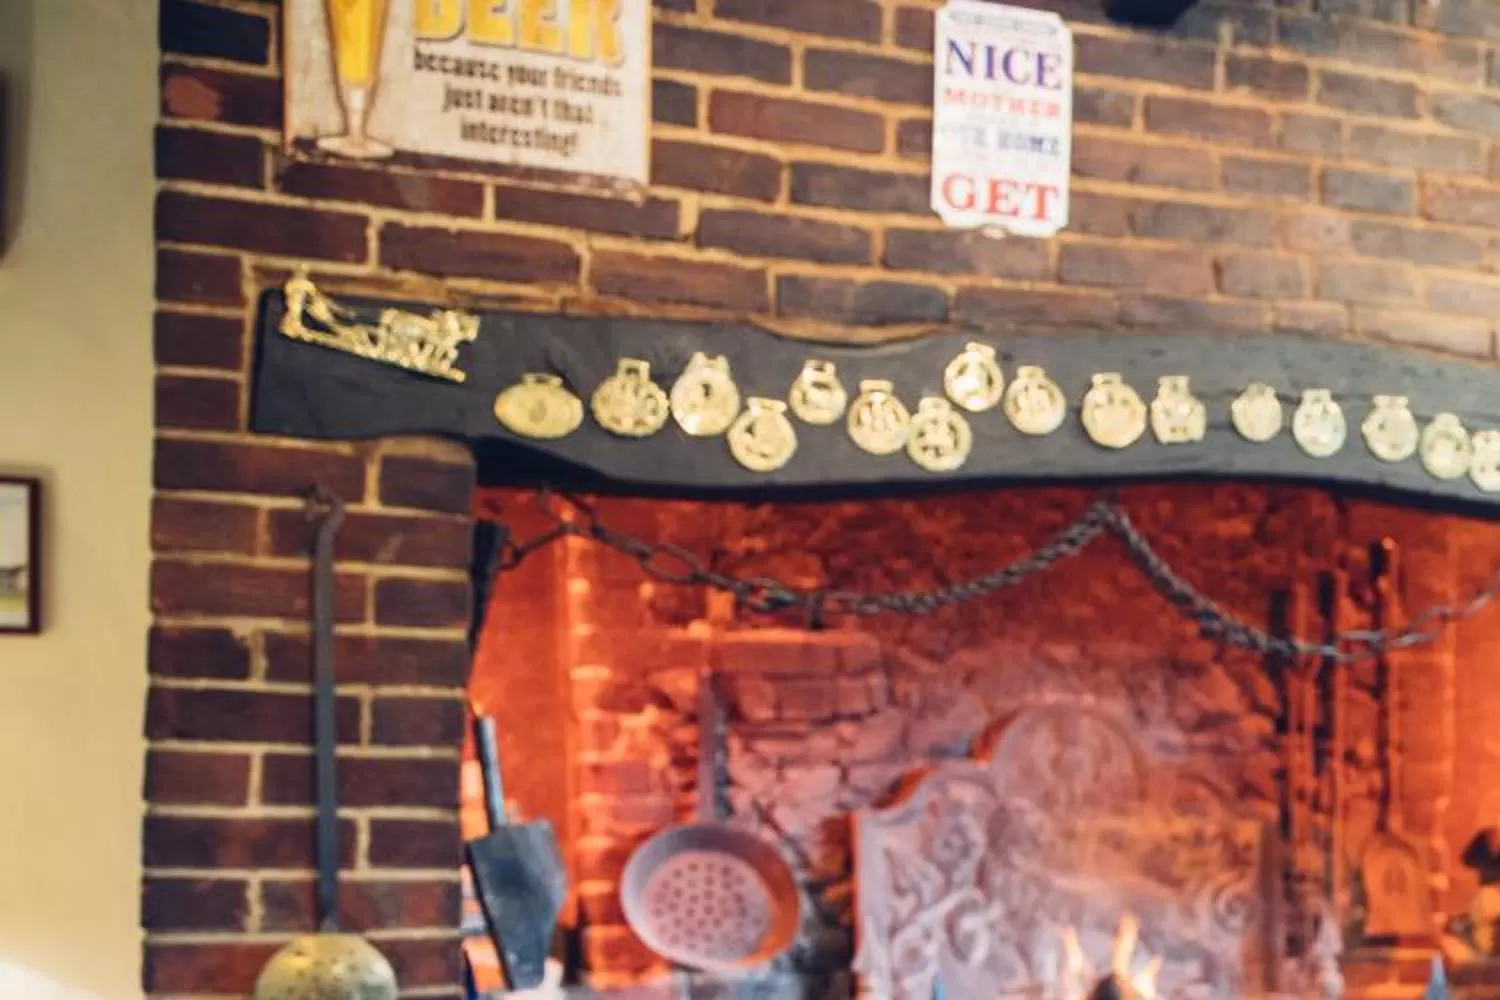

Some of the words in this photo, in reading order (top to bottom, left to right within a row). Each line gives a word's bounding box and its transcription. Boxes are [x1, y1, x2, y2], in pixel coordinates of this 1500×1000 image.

[413, 46, 501, 82] because
[506, 64, 548, 88] your
[944, 38, 1062, 91] NICE
[442, 83, 484, 113] just
[941, 170, 1057, 222] GET
